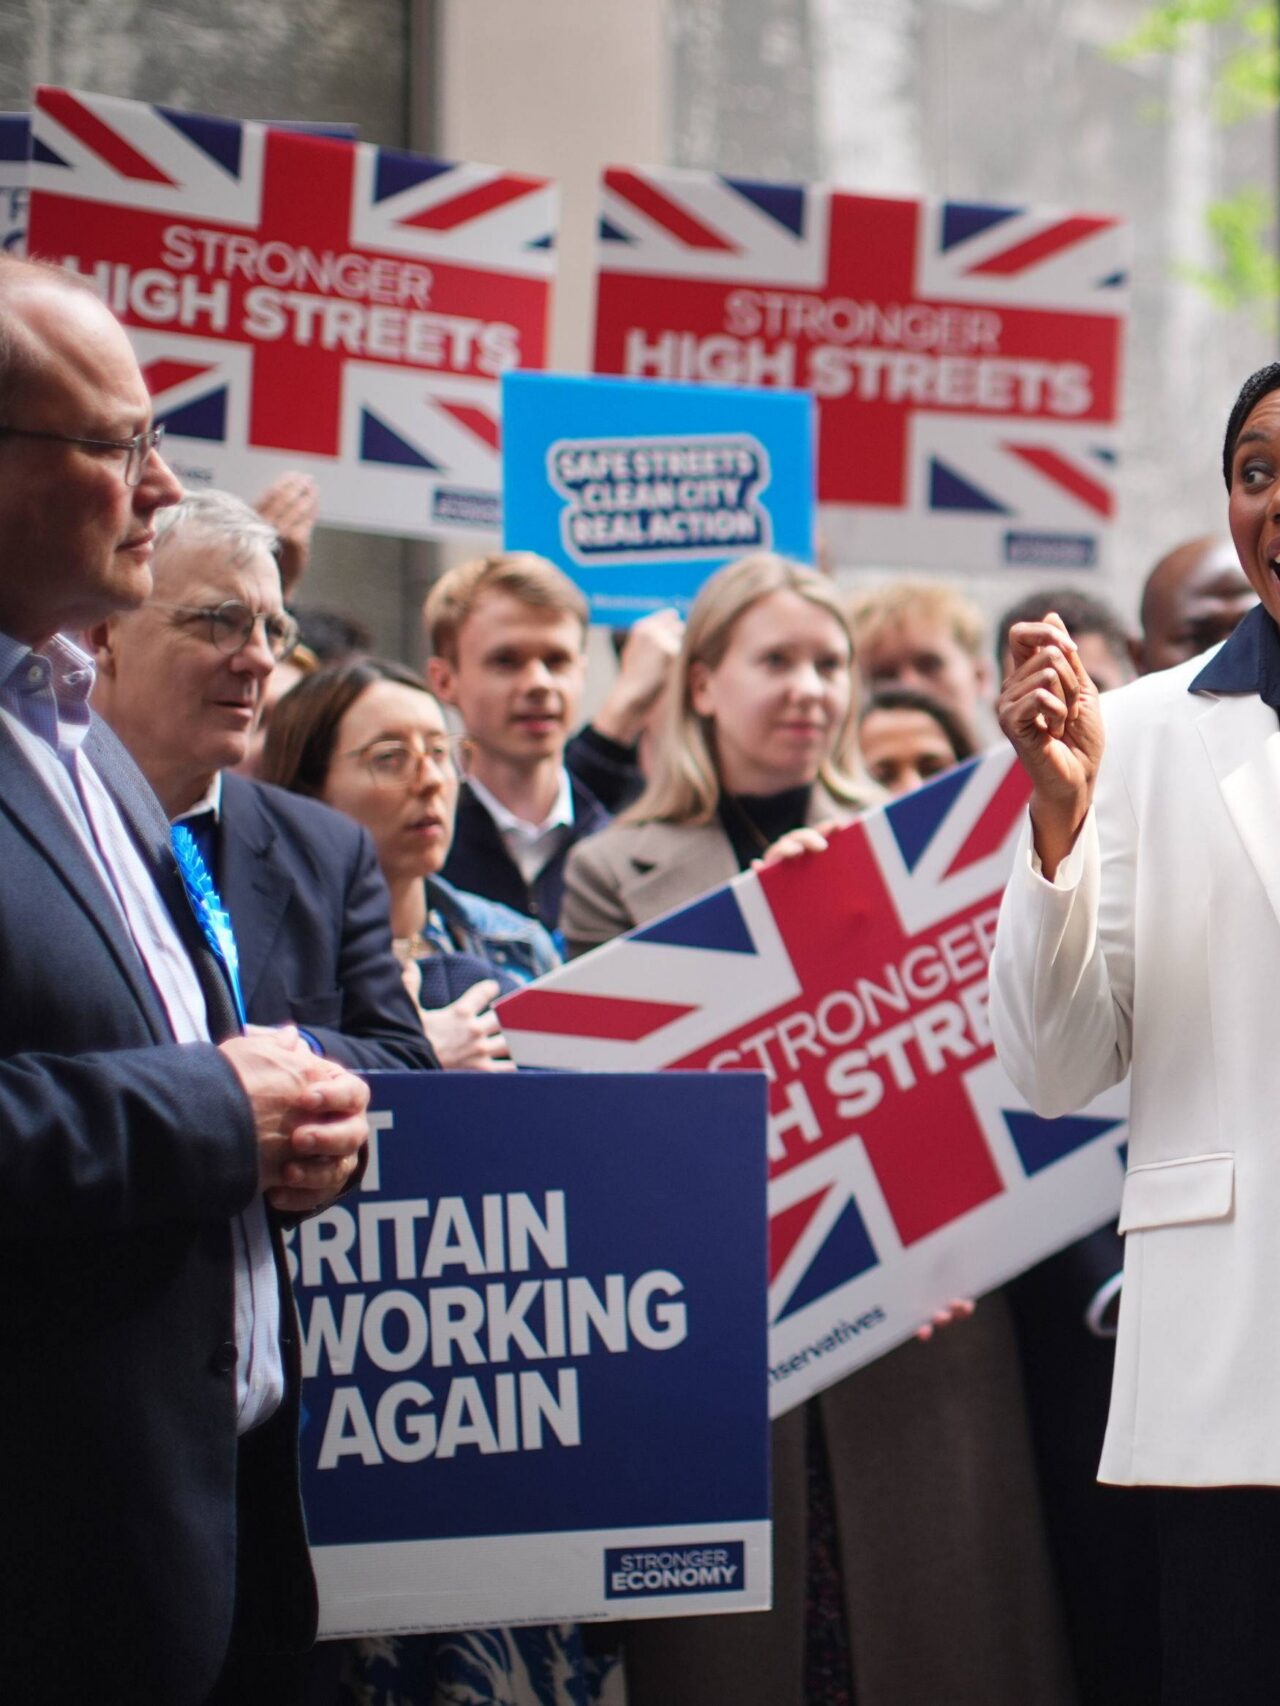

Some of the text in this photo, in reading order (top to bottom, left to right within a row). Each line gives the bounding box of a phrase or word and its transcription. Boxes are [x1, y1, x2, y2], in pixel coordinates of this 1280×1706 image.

[161, 225, 433, 308] STRONGER
[243, 286, 521, 373] STREETS
[724, 291, 1002, 354] STRONGER
[626, 327, 1092, 416] HIGH STREETS
[558, 450, 753, 480] SAFE STREETS
[582, 479, 740, 510] CLEAN CITY
[573, 511, 756, 545] REAL ACTION
[297, 1270, 687, 1378] WORKING
[316, 1368, 581, 1470] AGAIN
[612, 1564, 738, 1592] ECONOMY
[620, 1549, 729, 1572] STRONGER
